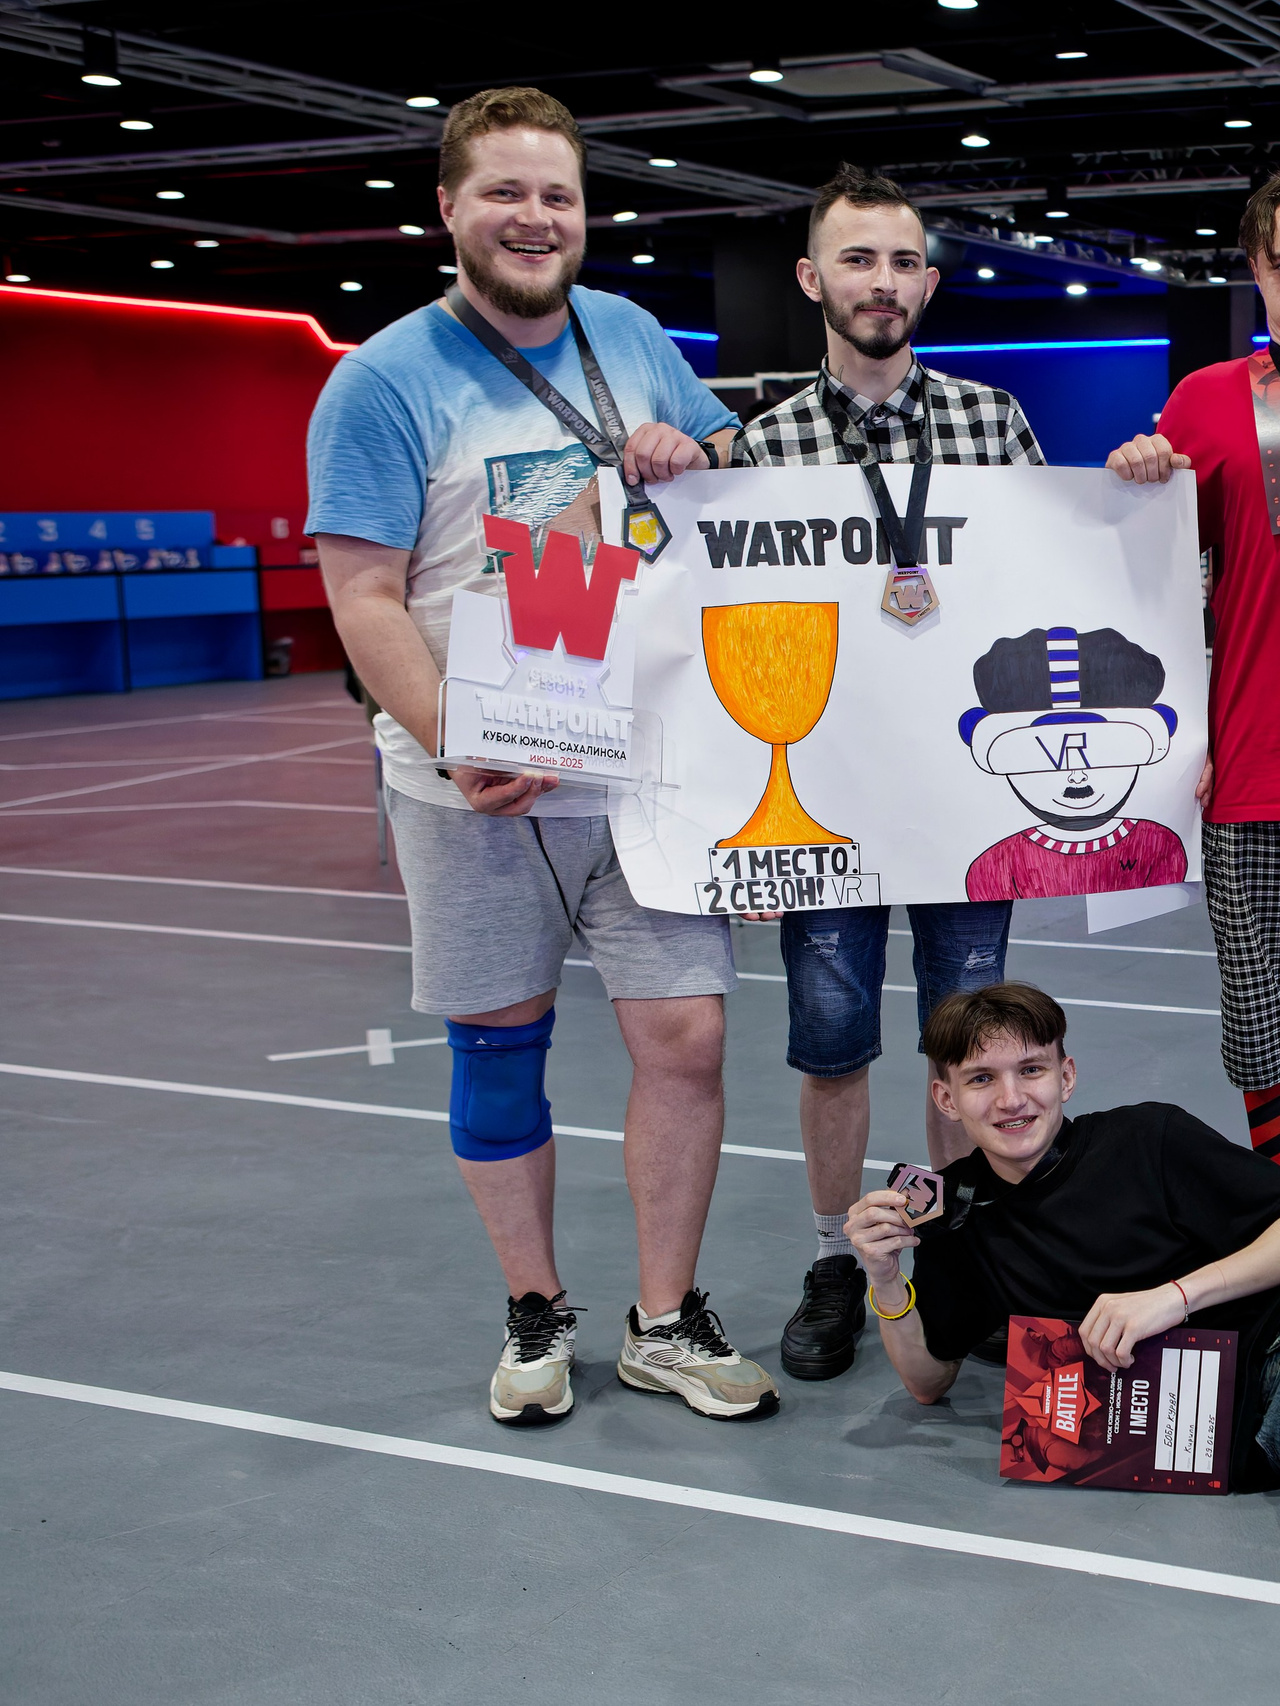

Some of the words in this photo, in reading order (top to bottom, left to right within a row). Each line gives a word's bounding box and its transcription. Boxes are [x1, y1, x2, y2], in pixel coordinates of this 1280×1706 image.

[546, 390, 602, 445] WARPOINT
[590, 376, 623, 437] WARPOINT
[37, 519, 58, 541] 3
[88, 519, 107, 540] 4
[135, 518, 155, 540] 5
[696, 516, 969, 569] WARPOIT
[483, 513, 641, 661] W
[475, 692, 635, 743] WARPOINT
[482, 730, 518, 745] КУБОК
[519, 735, 627, 760] ЮЖНО-САХАЛИНСКА
[560, 756, 584, 769] 2025
[1034, 732, 1092, 771] VR
[722, 849, 742, 879] 1
[748, 846, 848, 878] МЕСТО
[703, 882, 728, 914] 2
[730, 877, 825, 911] СЕЗОН!
[831, 876, 863, 905] VR
[1056, 1372, 1079, 1433] BATTLE
[1108, 1372, 1117, 1426] ЮЖНО-САХАЛИНС
[1130, 1379, 1150, 1428] МЕСТО
[1167, 1392, 1177, 1423] КУРВА
[1164, 1424, 1174, 1448] БОБР
